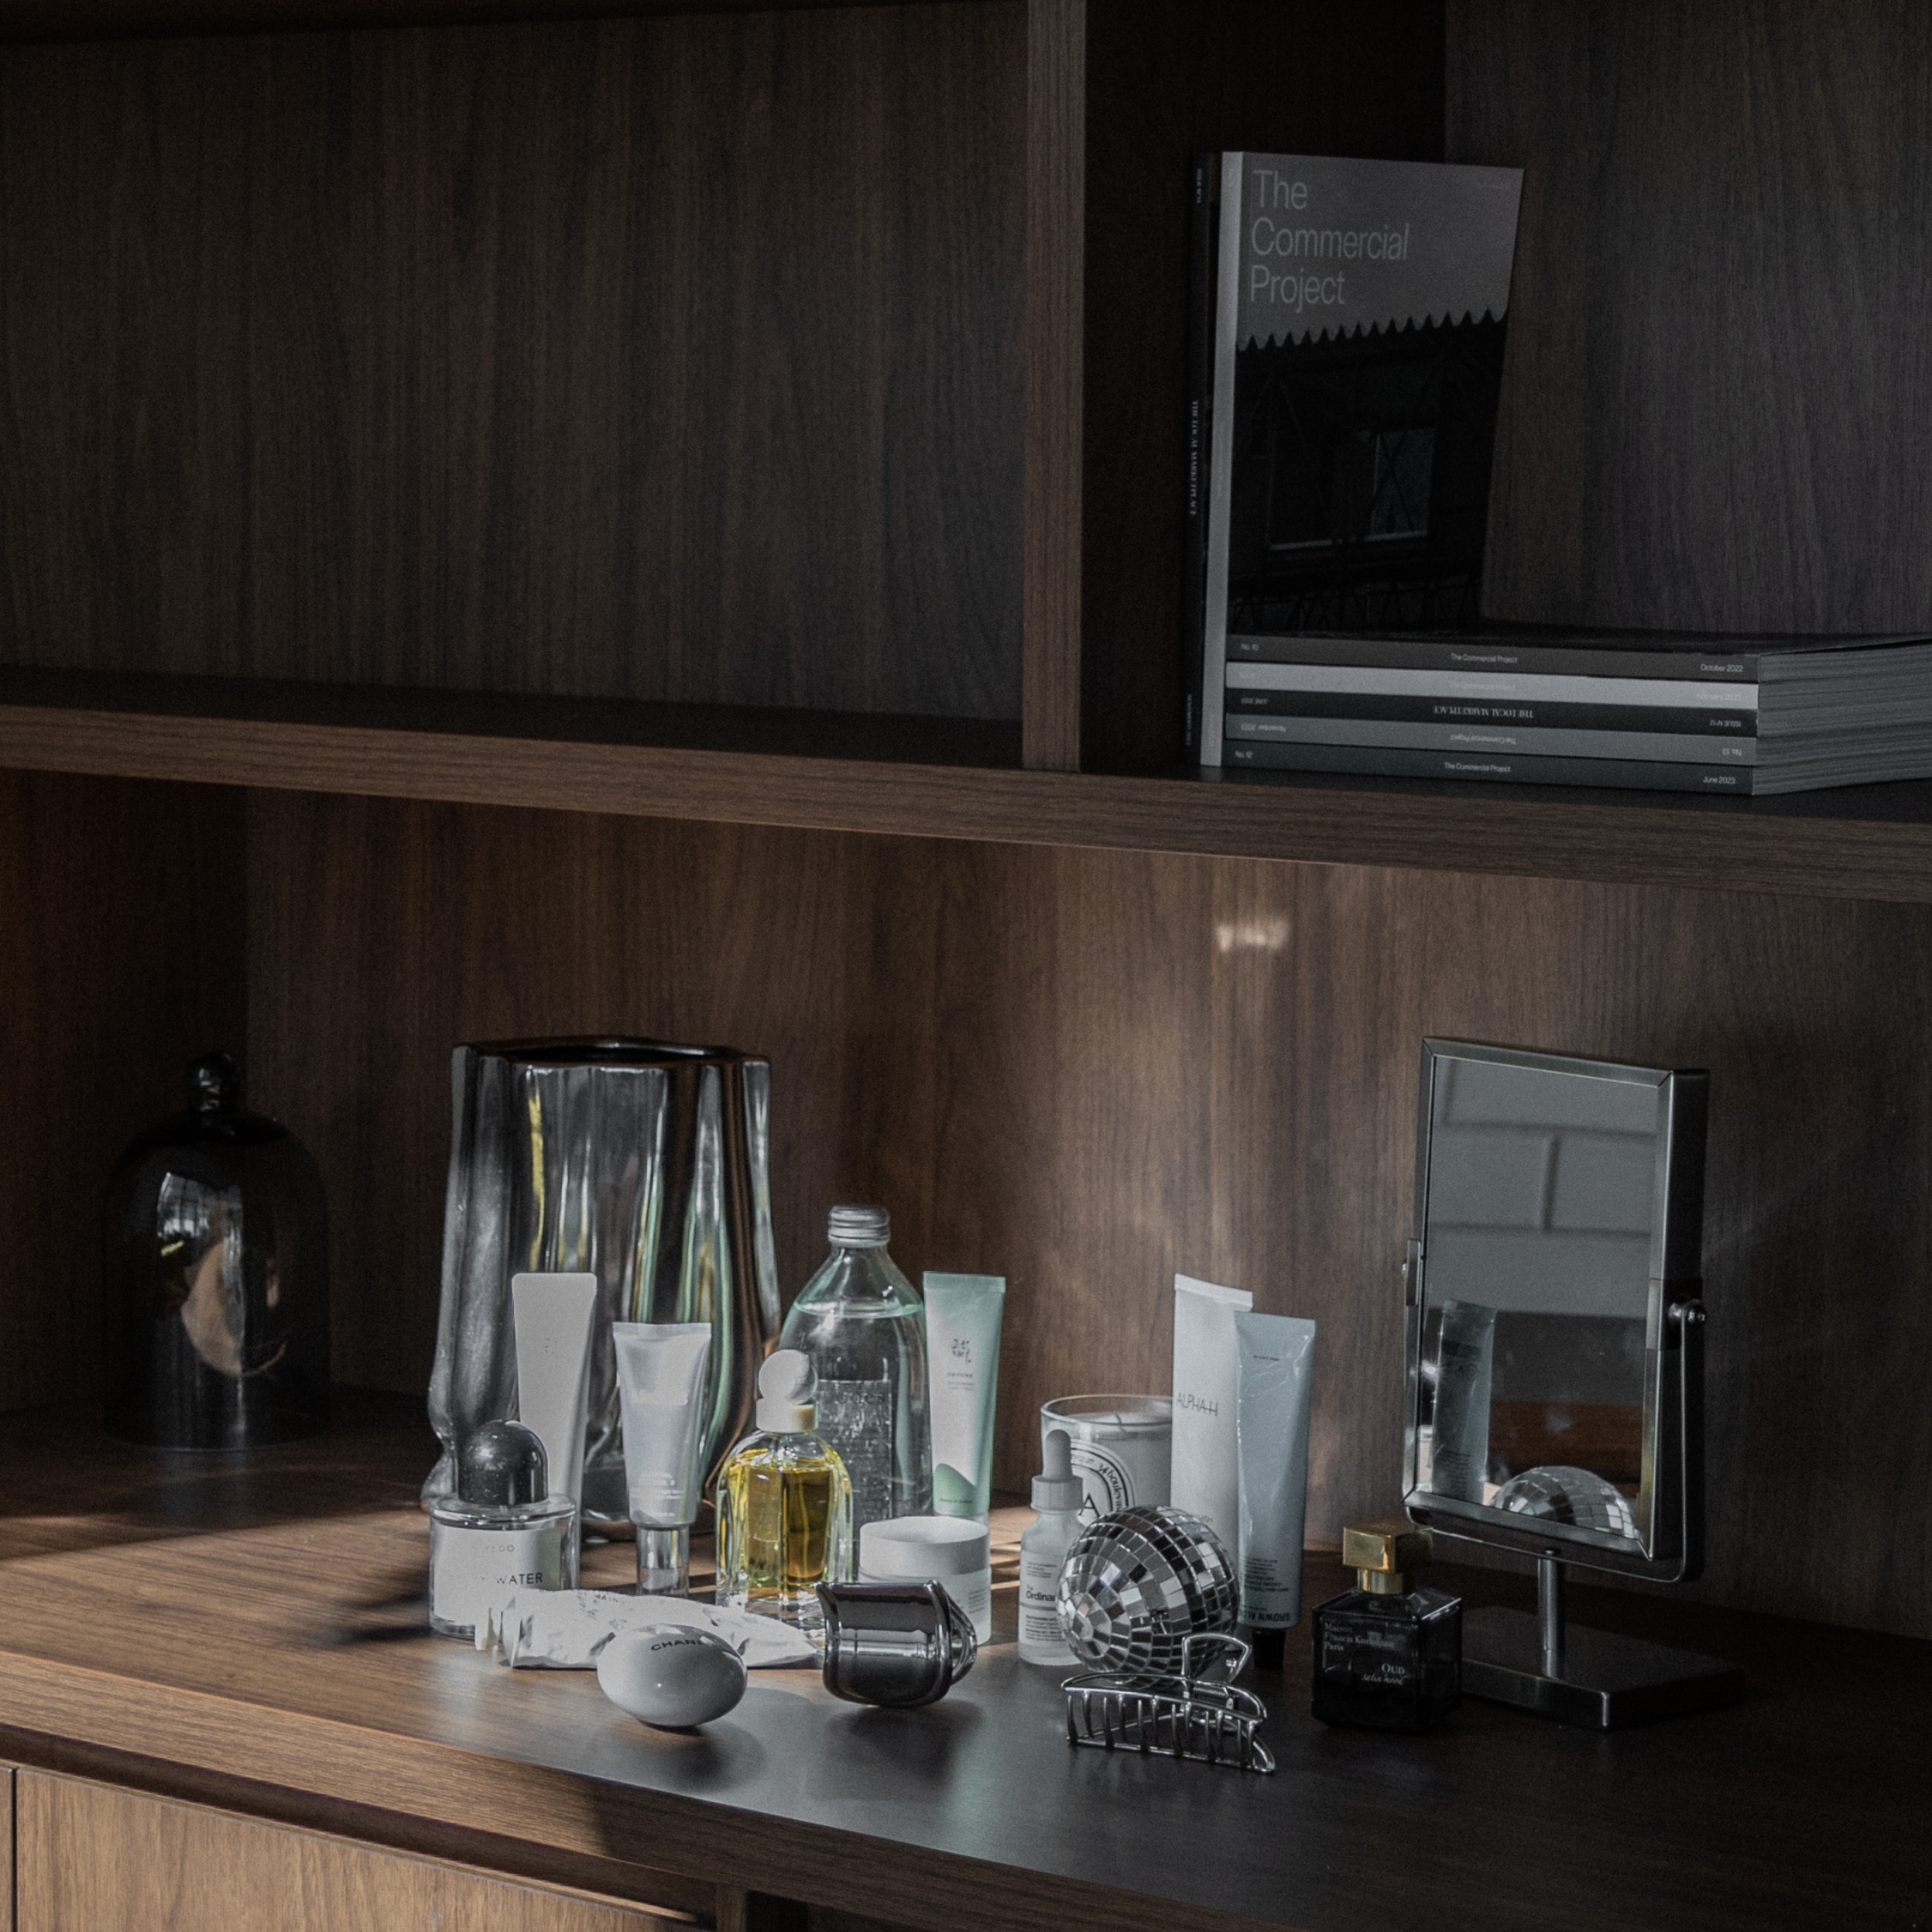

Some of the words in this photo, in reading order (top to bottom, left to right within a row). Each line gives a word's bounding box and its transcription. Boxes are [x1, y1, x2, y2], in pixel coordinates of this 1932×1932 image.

[1252, 169, 1307, 210] The
[1251, 217, 1410, 260] Commercial
[1250, 265, 1345, 313] Project
[1462, 653, 1496, 663] Commercial
[1497, 655, 1518, 665] Project
[1700, 663, 1725, 672] October
[1491, 707, 1516, 718] LOCAL
[1455, 762, 1489, 772] Commercial
[1490, 764, 1511, 773] Project
[1718, 776, 1736, 785] 2023
[495, 1571, 543, 1585] WATER
[1324, 1641, 1345, 1651] Paris
[1381, 1663, 1406, 1675] OUD
